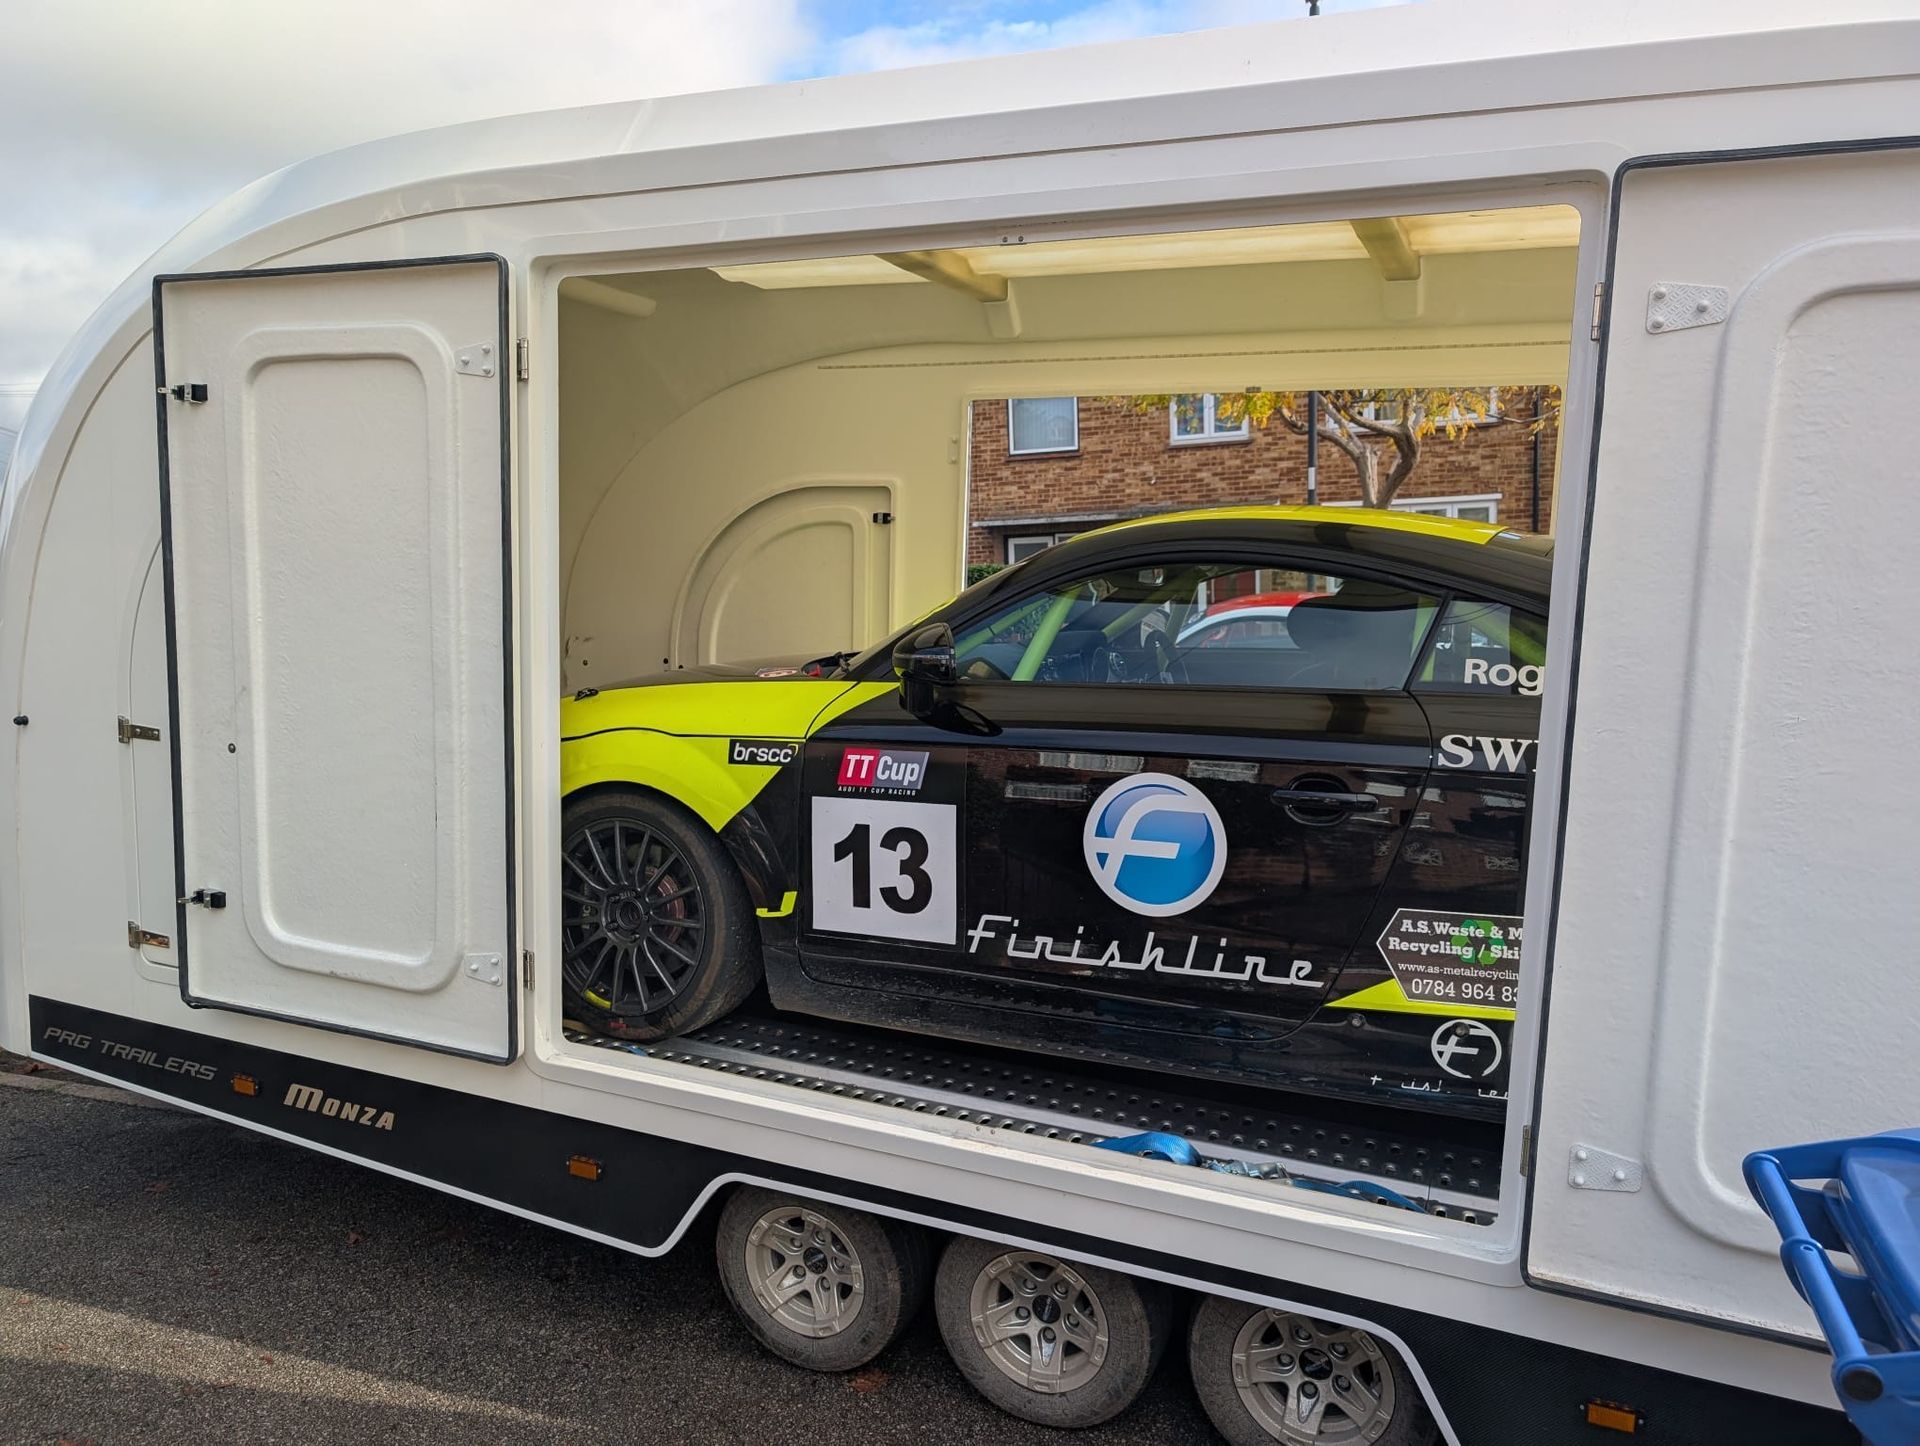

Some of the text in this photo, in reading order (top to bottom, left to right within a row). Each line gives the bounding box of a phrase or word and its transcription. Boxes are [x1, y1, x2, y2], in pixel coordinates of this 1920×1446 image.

[733, 742, 793, 763] brscc
[1437, 734, 1539, 773] SW
[846, 754, 920, 786] TT Cup
[888, 788, 916, 796] RACING
[834, 823, 932, 914] 13
[1433, 921, 1485, 938] Waste
[1490, 925, 1503, 939] &
[1388, 937, 1474, 959] Recycling
[1477, 944, 1485, 958] /
[1411, 978, 1456, 997] 0784
[1461, 982, 1496, 1001] 964
[44, 1027, 218, 1081] PRG TRAILERS
